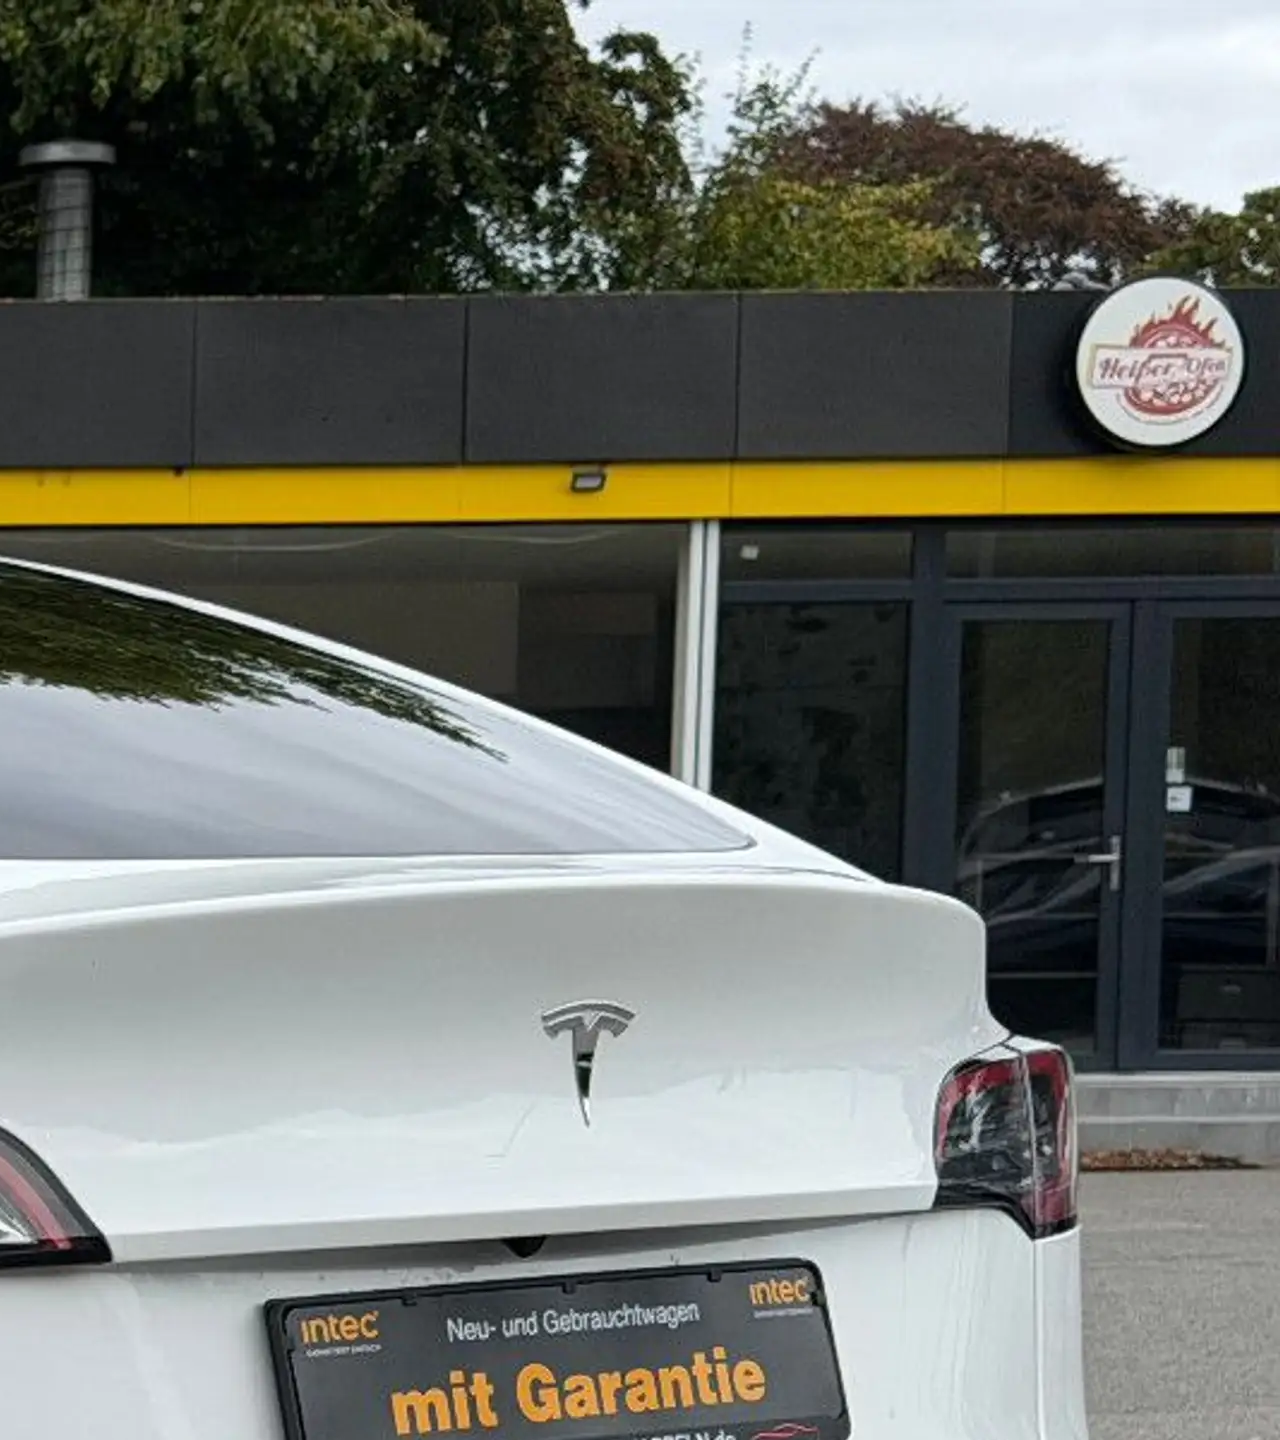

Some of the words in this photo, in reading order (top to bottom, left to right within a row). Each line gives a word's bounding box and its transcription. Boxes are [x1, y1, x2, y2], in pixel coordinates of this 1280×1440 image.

[300, 1311, 380, 1344] intec
[447, 1317, 496, 1342] Neu-
[502, 1311, 538, 1336] und
[543, 1301, 700, 1333] Gebrauchtwagen
[391, 1369, 498, 1436] mit
[516, 1346, 767, 1423] Garantie
